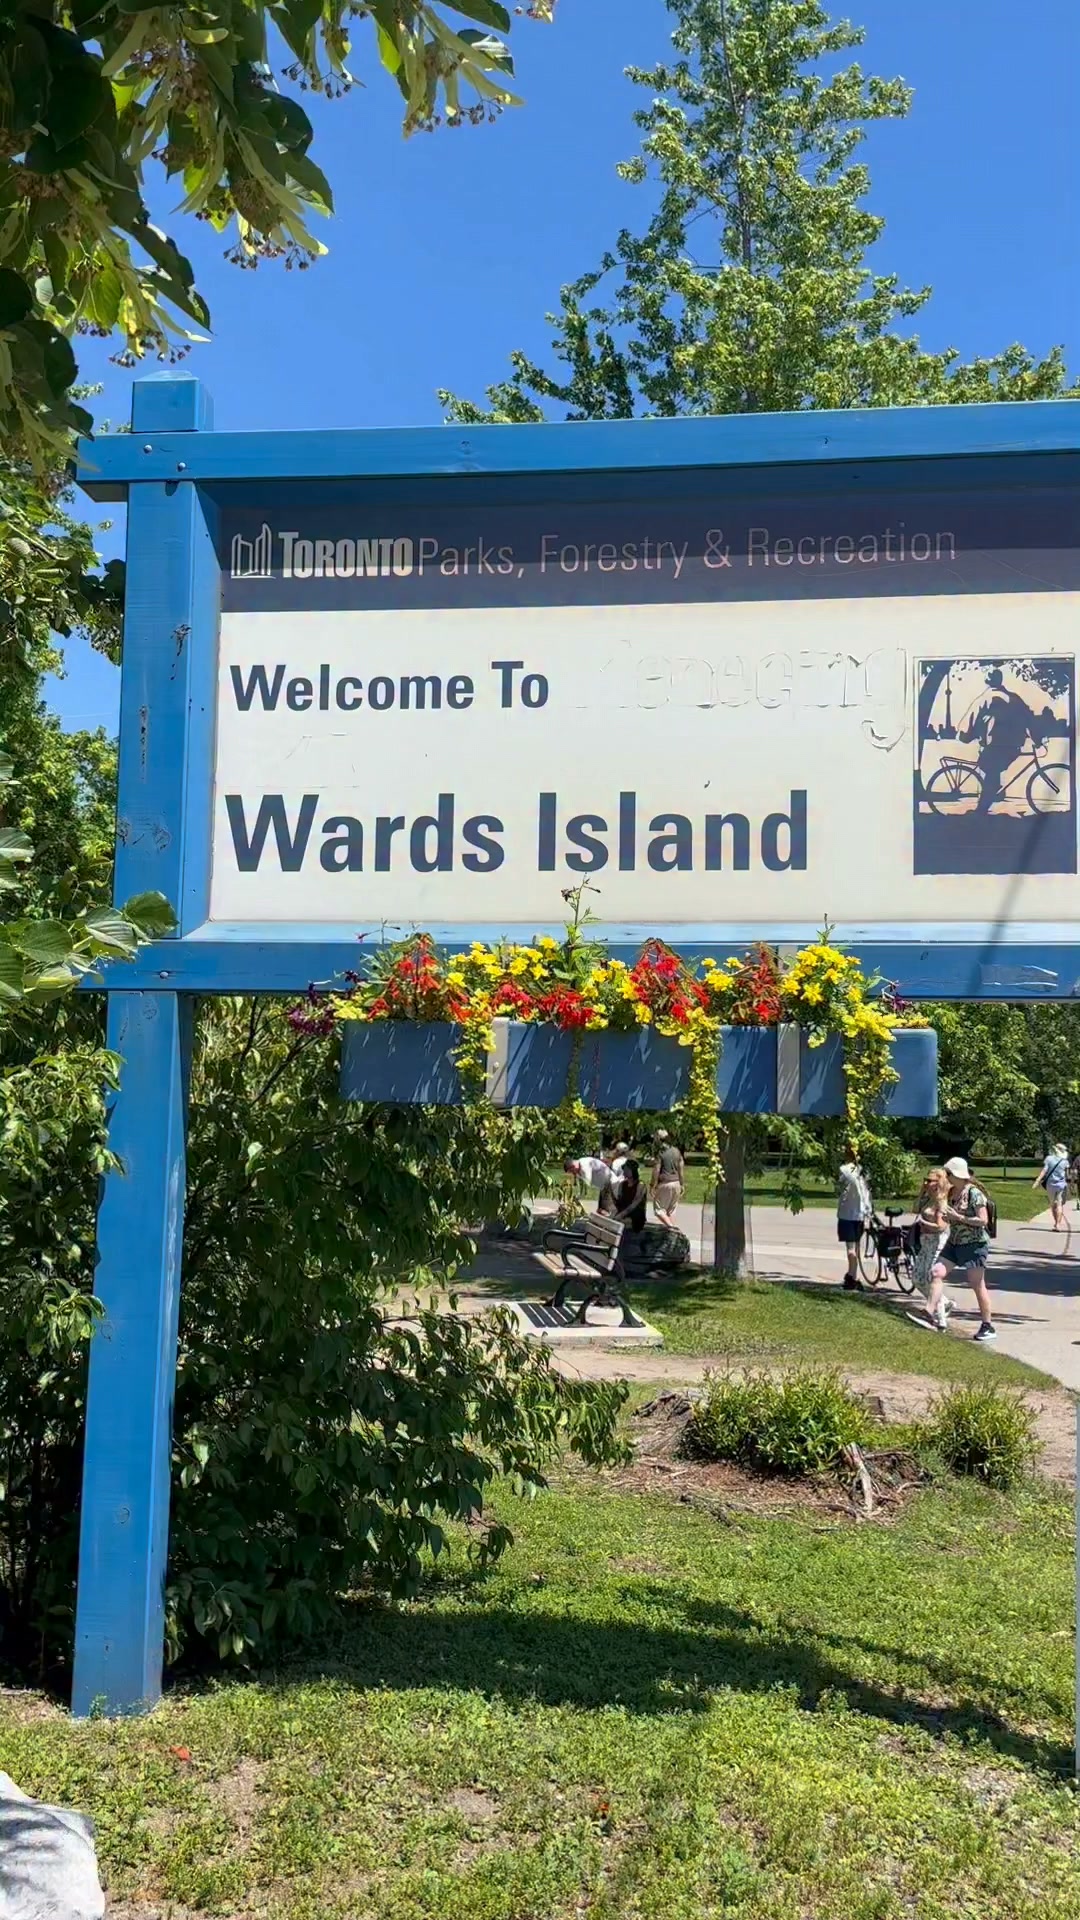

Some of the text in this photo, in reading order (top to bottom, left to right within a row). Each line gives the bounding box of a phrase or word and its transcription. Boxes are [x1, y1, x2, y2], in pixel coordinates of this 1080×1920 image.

[279, 522, 957, 579] TORONTO Parks, Forestry & Recreation
[230, 663, 475, 711] Welcome
[491, 661, 549, 708] To
[225, 789, 808, 872] Wards Island
